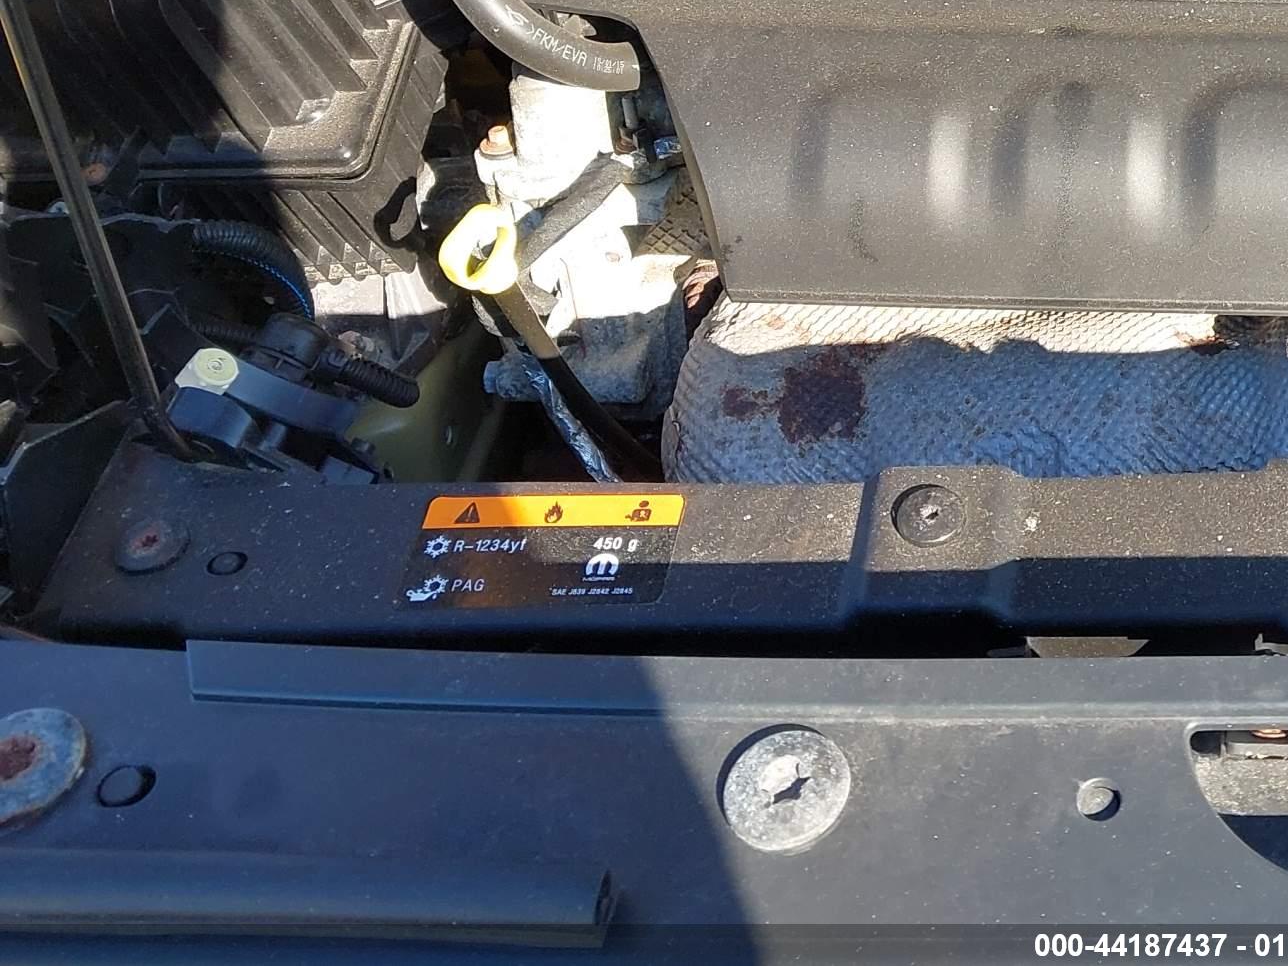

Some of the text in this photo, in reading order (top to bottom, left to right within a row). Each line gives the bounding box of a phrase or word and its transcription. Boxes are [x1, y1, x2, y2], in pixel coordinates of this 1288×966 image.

[452, 537, 638, 553] R-1234yf 450 g
[451, 579, 485, 592] PAG
